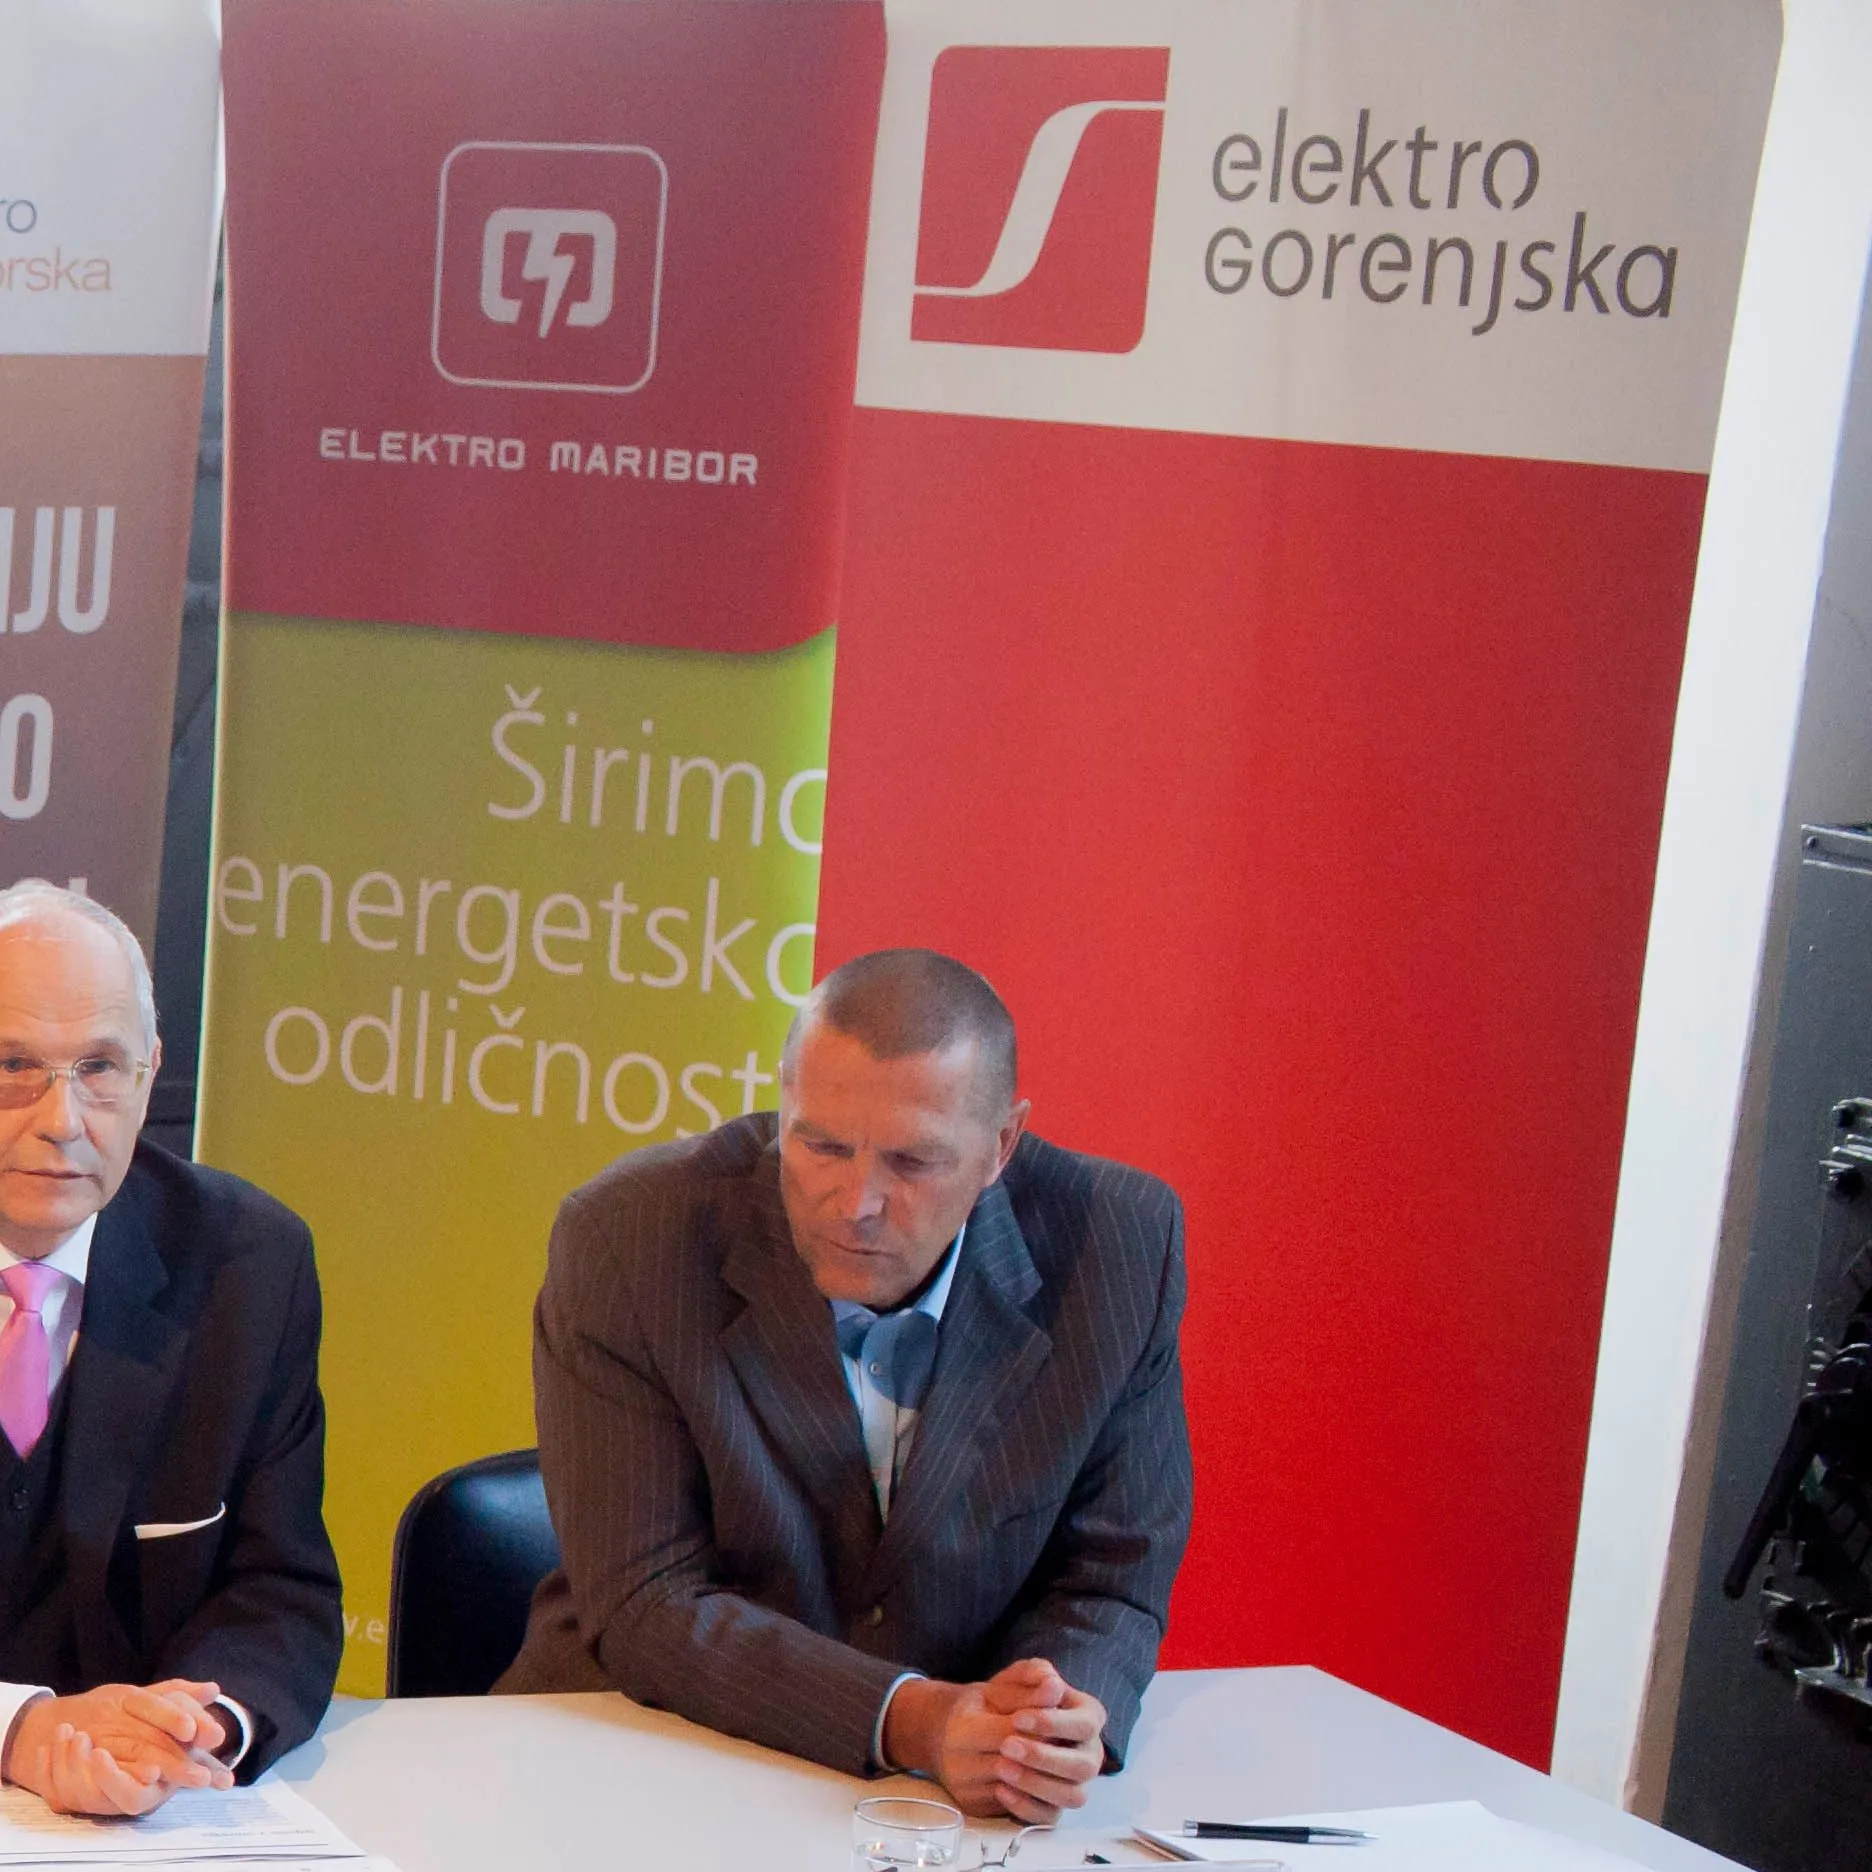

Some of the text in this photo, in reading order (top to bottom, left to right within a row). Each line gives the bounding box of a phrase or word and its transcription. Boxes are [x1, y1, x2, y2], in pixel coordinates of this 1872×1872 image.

[1210, 106, 1541, 210] elektro
[318, 426, 760, 488] ELEKTRO MARIBOR
